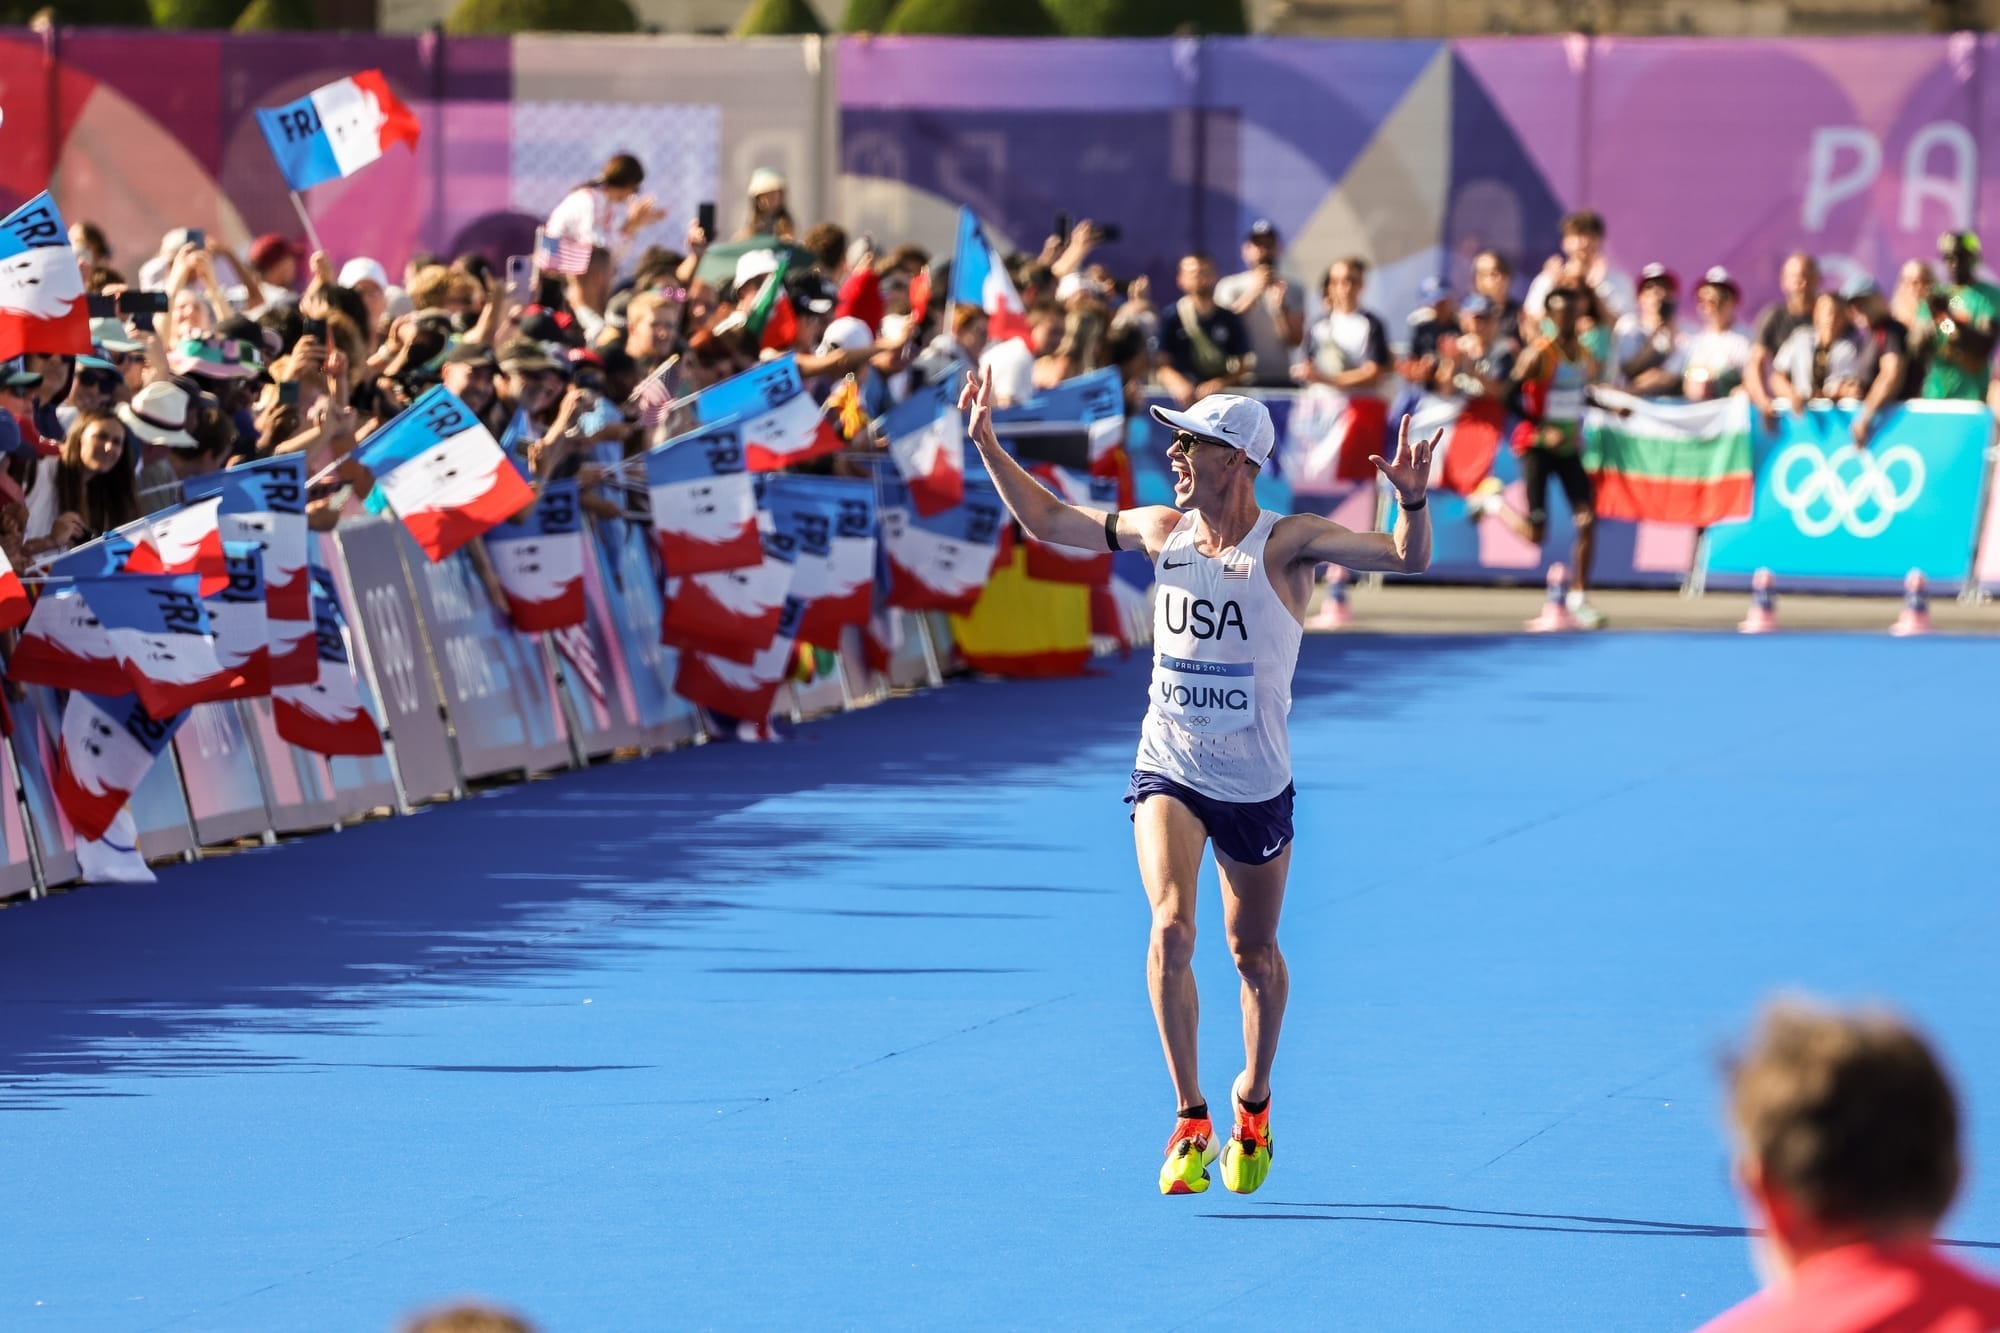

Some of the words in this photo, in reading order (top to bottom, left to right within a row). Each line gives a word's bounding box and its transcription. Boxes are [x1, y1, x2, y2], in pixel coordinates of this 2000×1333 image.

[1165, 592, 1248, 641] USA
[1175, 661, 1201, 672] PARIS
[1203, 664, 1227, 673] 2024
[1161, 681, 1248, 711] YOUNG
